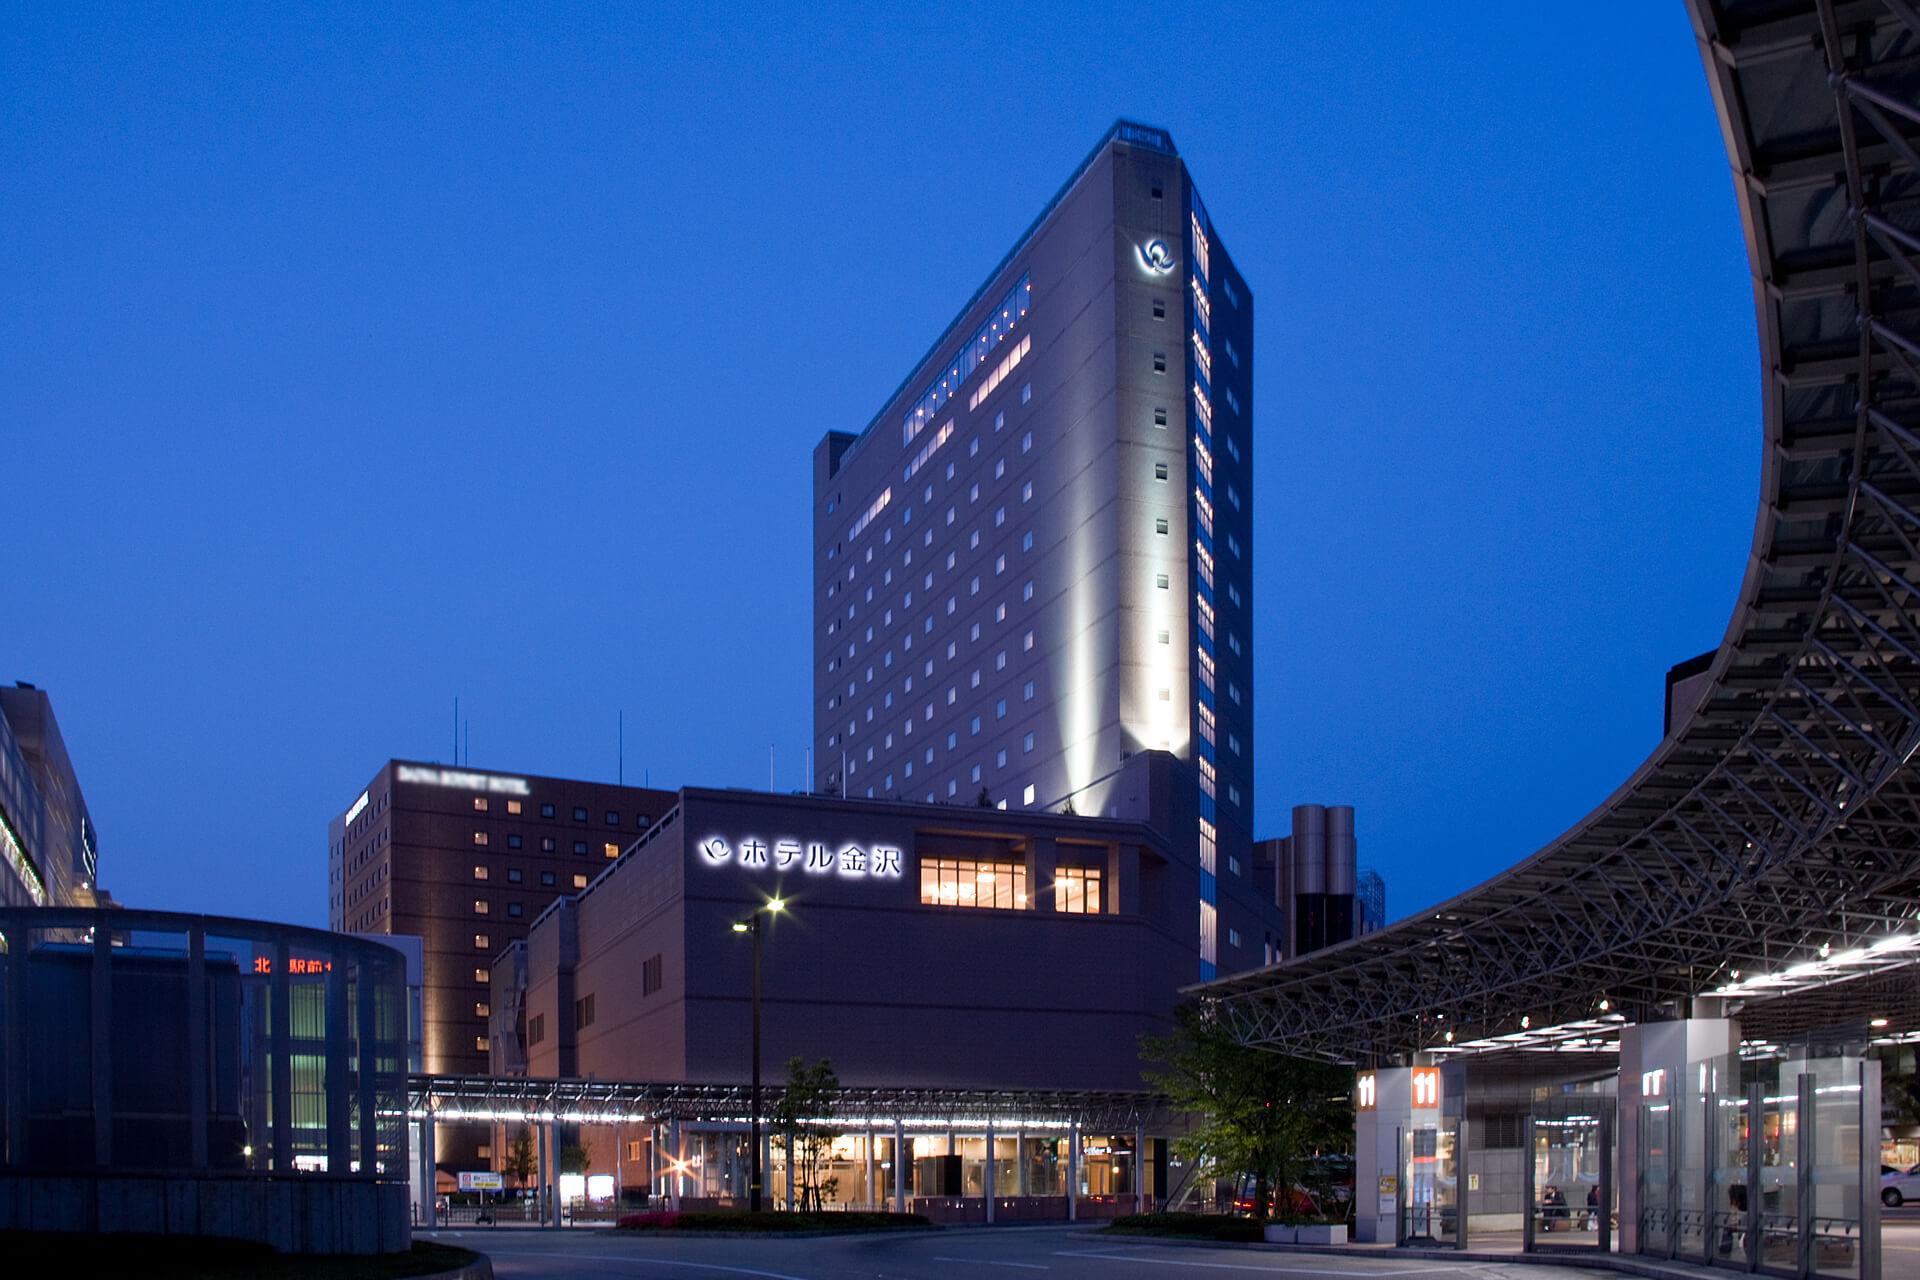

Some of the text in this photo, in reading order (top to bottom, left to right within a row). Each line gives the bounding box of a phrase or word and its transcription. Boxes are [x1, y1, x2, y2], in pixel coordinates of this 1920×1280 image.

[743, 840, 901, 874] ホテル金沢
[1358, 1075, 1375, 1107] 11
[1414, 1072, 1436, 1104] 11
